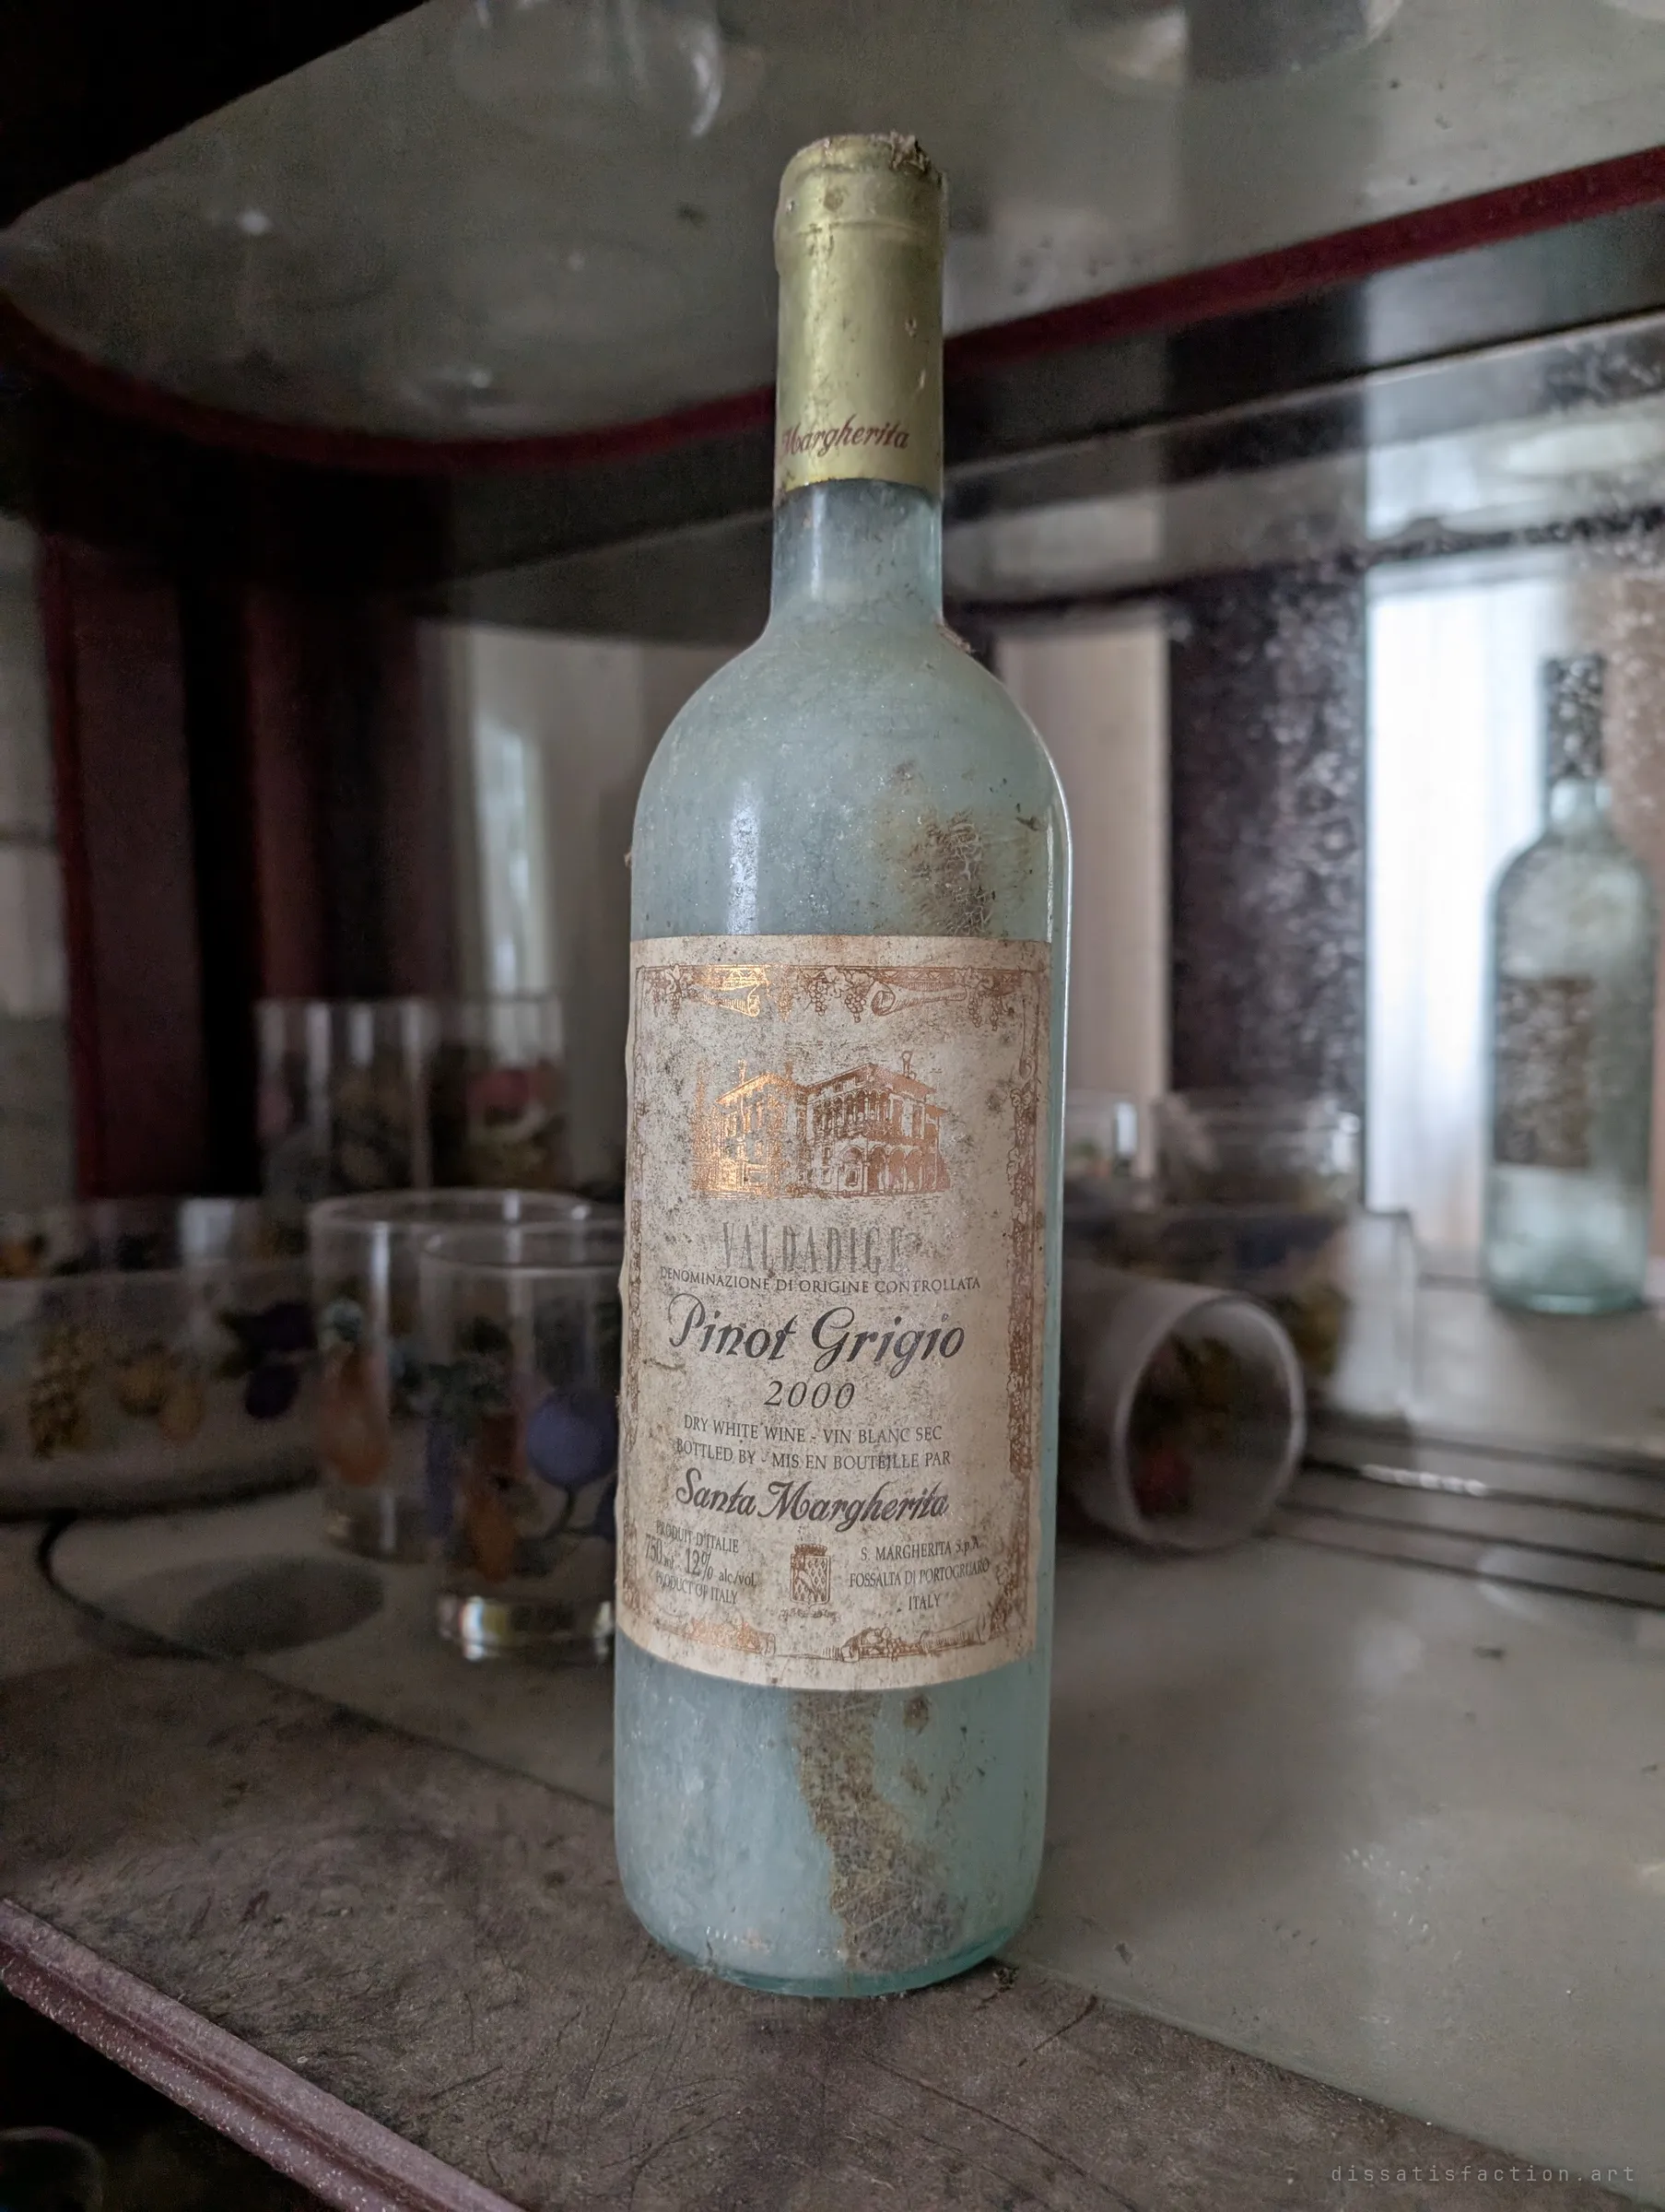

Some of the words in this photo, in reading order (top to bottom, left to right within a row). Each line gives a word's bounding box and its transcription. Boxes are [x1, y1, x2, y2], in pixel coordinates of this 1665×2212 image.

[660, 1265, 769, 1290] DENOMINAZIONE
[776, 1278, 794, 1291] DI
[799, 1279, 869, 1293] ORIGINE
[874, 1277, 981, 1293] CONTROLLATA
[668, 1293, 797, 1360] Pinot
[811, 1306, 965, 1379] Grigio
[764, 1381, 855, 1408] 2000
[684, 1415, 708, 1432] DRY
[713, 1419, 758, 1440] WHITE
[764, 1426, 804, 1442] WINE
[823, 1429, 851, 1444] VIN
[859, 1427, 910, 1442] BLANC
[915, 1426, 942, 1441] SEC
[676, 1439, 733, 1462] BOTTLED
[739, 1451, 756, 1465] BY
[771, 1453, 800, 1468] MIS
[806, 1455, 827, 1470] EN
[833, 1452, 920, 1471] BOUTEILLE
[925, 1451, 951, 1466] PAR
[676, 1467, 756, 1516] Santa
[757, 1479, 949, 1533] Margherita
[656, 1520, 692, 1544] PRODUIT
[645, 1533, 662, 1564] 750
[686, 1547, 714, 1582] 12%
[861, 1547, 870, 1561] S.
[875, 1540, 952, 1561] MARGHERITA
[656, 1570, 693, 1594] PRODUCT
[695, 1583, 709, 1602] OF
[710, 1586, 738, 1605] ITALY
[850, 1571, 901, 1588] FOSSALTA
[905, 1570, 916, 1584] DI
[920, 1558, 990, 1583] PORTOGRUARO
[909, 1593, 941, 1611] ITALY
